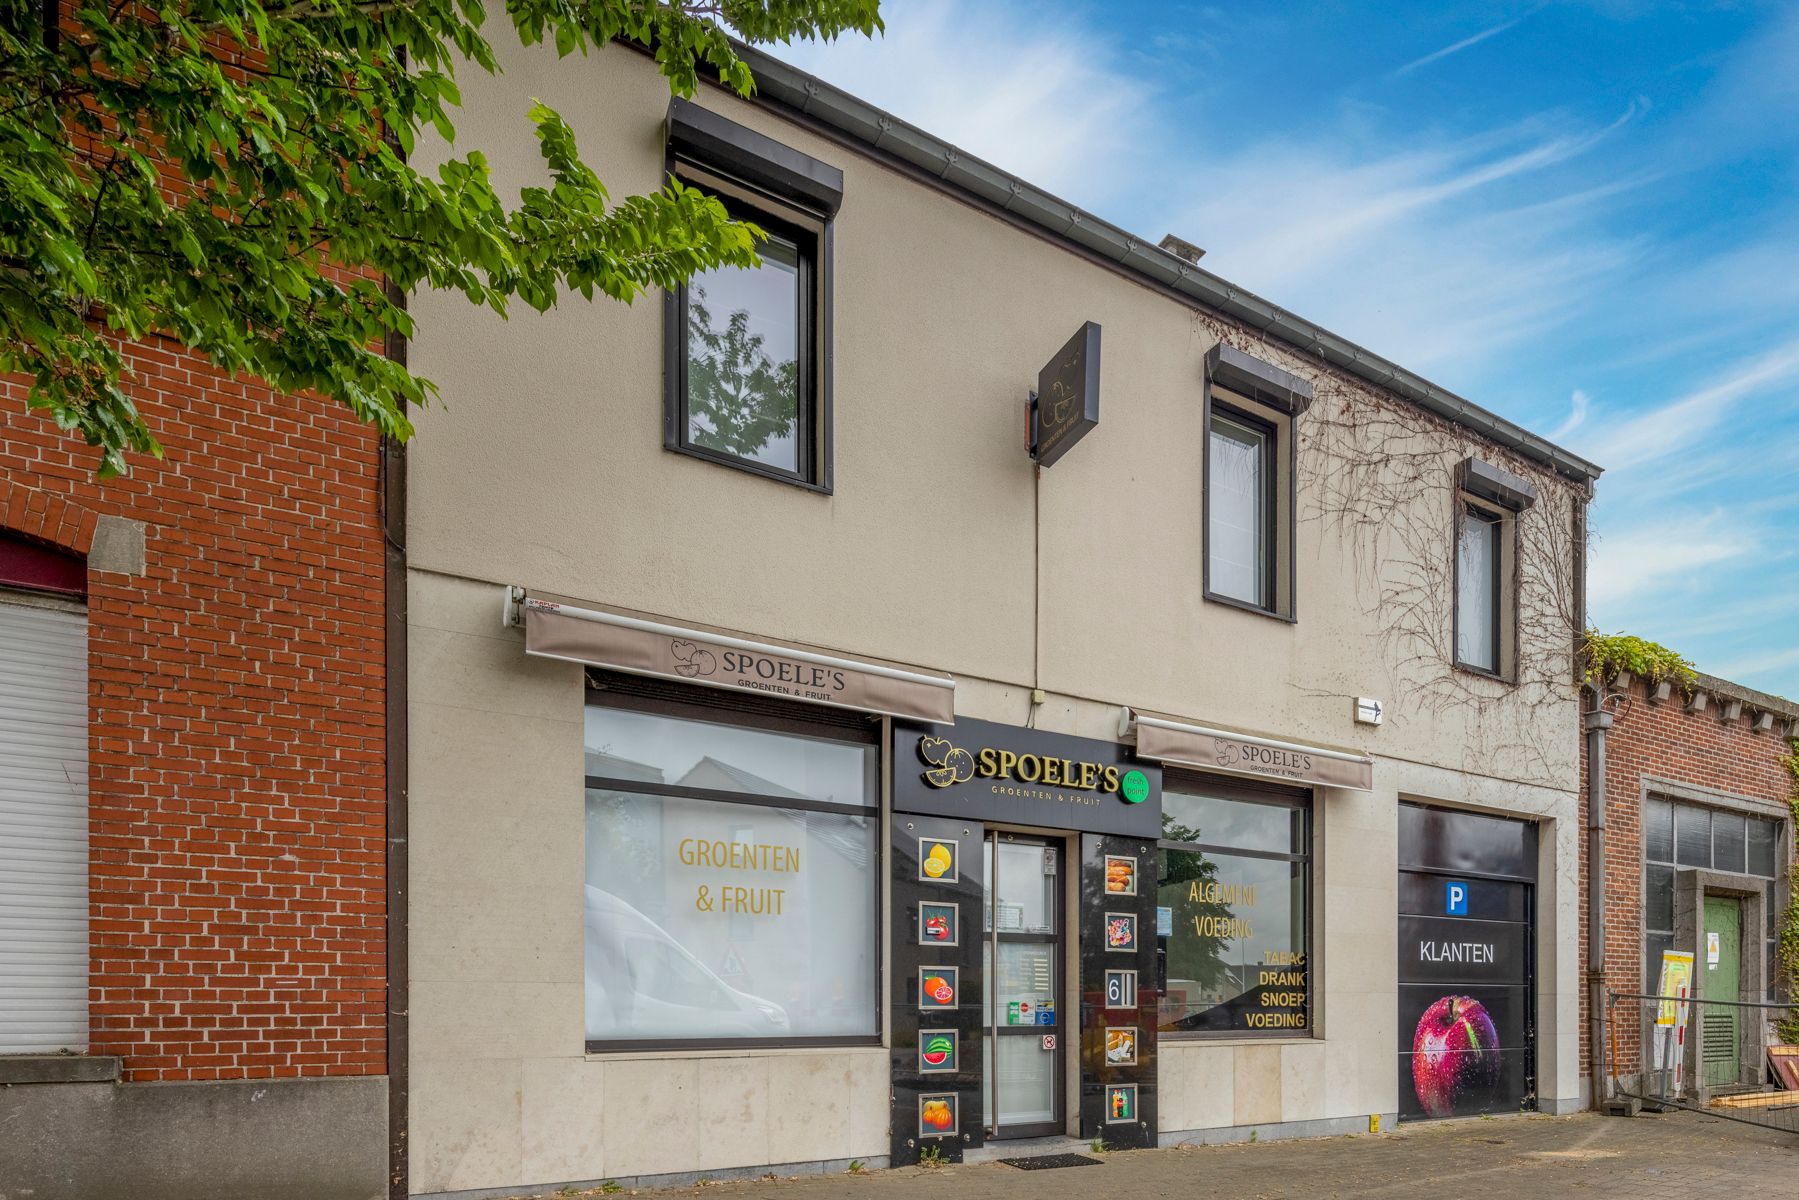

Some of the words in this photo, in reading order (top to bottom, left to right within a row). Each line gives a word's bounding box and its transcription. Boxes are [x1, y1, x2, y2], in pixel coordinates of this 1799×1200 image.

[722, 651, 845, 691] SPOELE'S
[737, 679, 789, 695] GROENTEN
[805, 690, 831, 701] FRUIT
[1241, 744, 1312, 770] SPOELE'S
[979, 747, 1120, 794] SPOELE'S
[1250, 764, 1280, 776] GROENTEN
[1287, 770, 1303, 778] FRUIT
[991, 785, 1053, 800] GROENTEN
[1057, 794, 1065, 802] &
[1070, 795, 1101, 807] FRUIT
[678, 838, 800, 873] GROENTEN
[695, 884, 714, 912] &
[721, 886, 786, 915] FRUIT
[1450, 886, 1464, 911] P
[1194, 915, 1254, 939] VOEDING
[1420, 940, 1494, 964] KLANTEN
[1259, 971, 1306, 987] DRANK
[1260, 992, 1306, 1007] SNOEP
[1245, 1013, 1306, 1028] VOEDING
